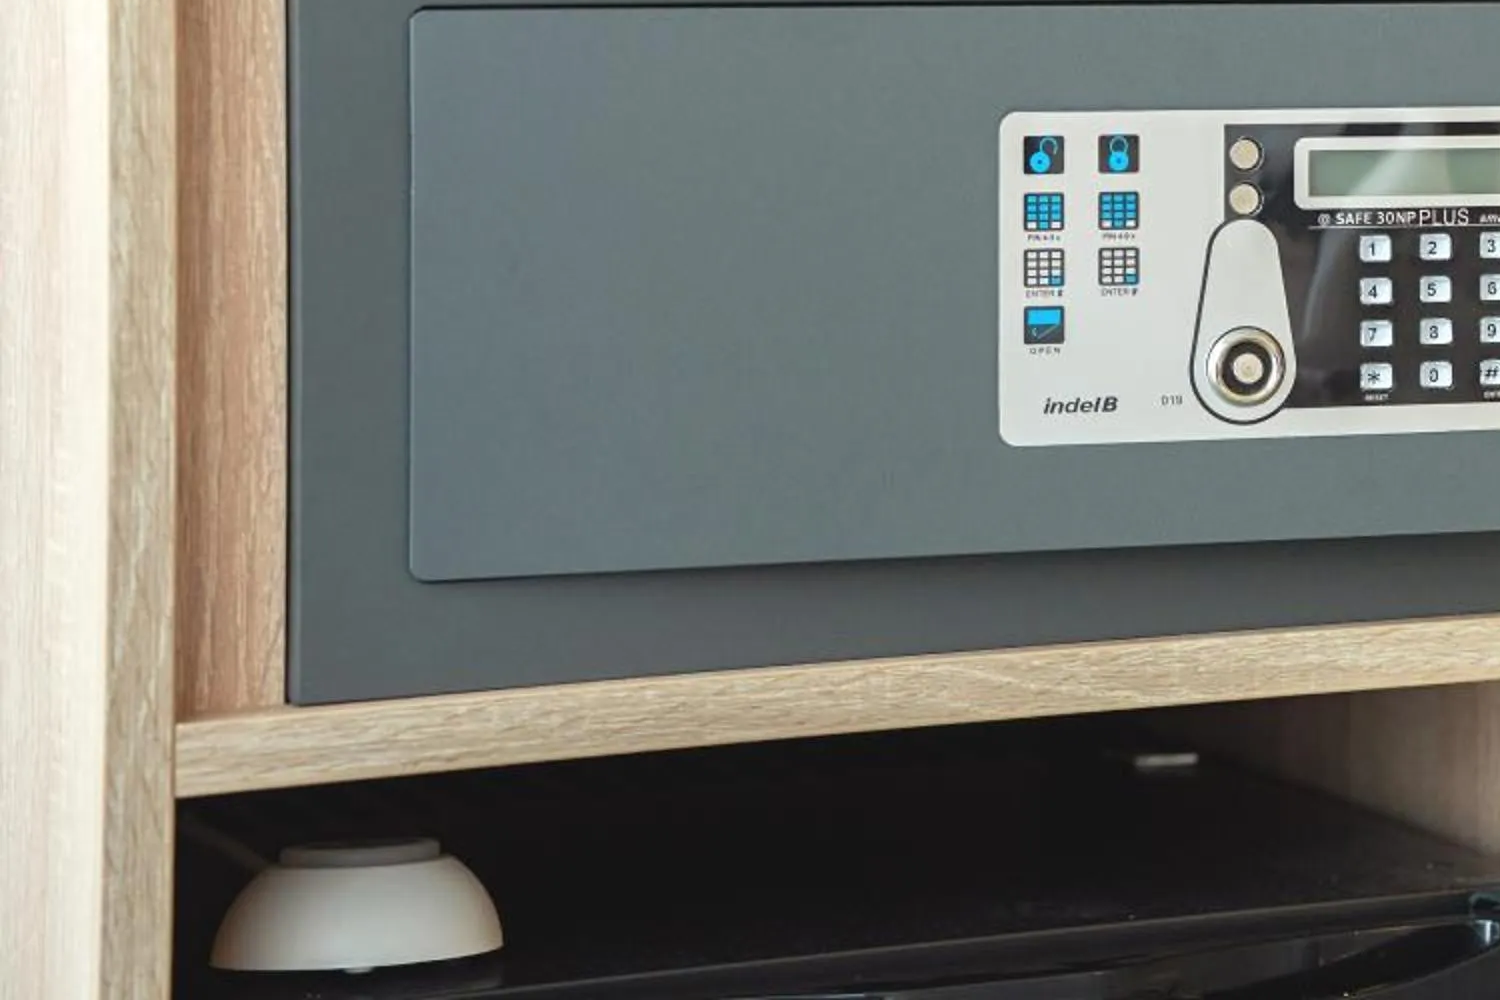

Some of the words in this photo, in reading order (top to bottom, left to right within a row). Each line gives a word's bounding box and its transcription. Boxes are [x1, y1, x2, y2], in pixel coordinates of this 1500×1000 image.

[1336, 213, 1372, 225] SAFE
[1428, 241, 1438, 255] 2
[1487, 239, 1497, 253] 3
[1368, 284, 1378, 299] 4
[1427, 283, 1437, 297] 5
[1487, 281, 1497, 295] 6
[1368, 327, 1378, 341] 7
[1429, 325, 1439, 339] 8
[1487, 324, 1497, 338] 9
[1429, 368, 1439, 382] 0
